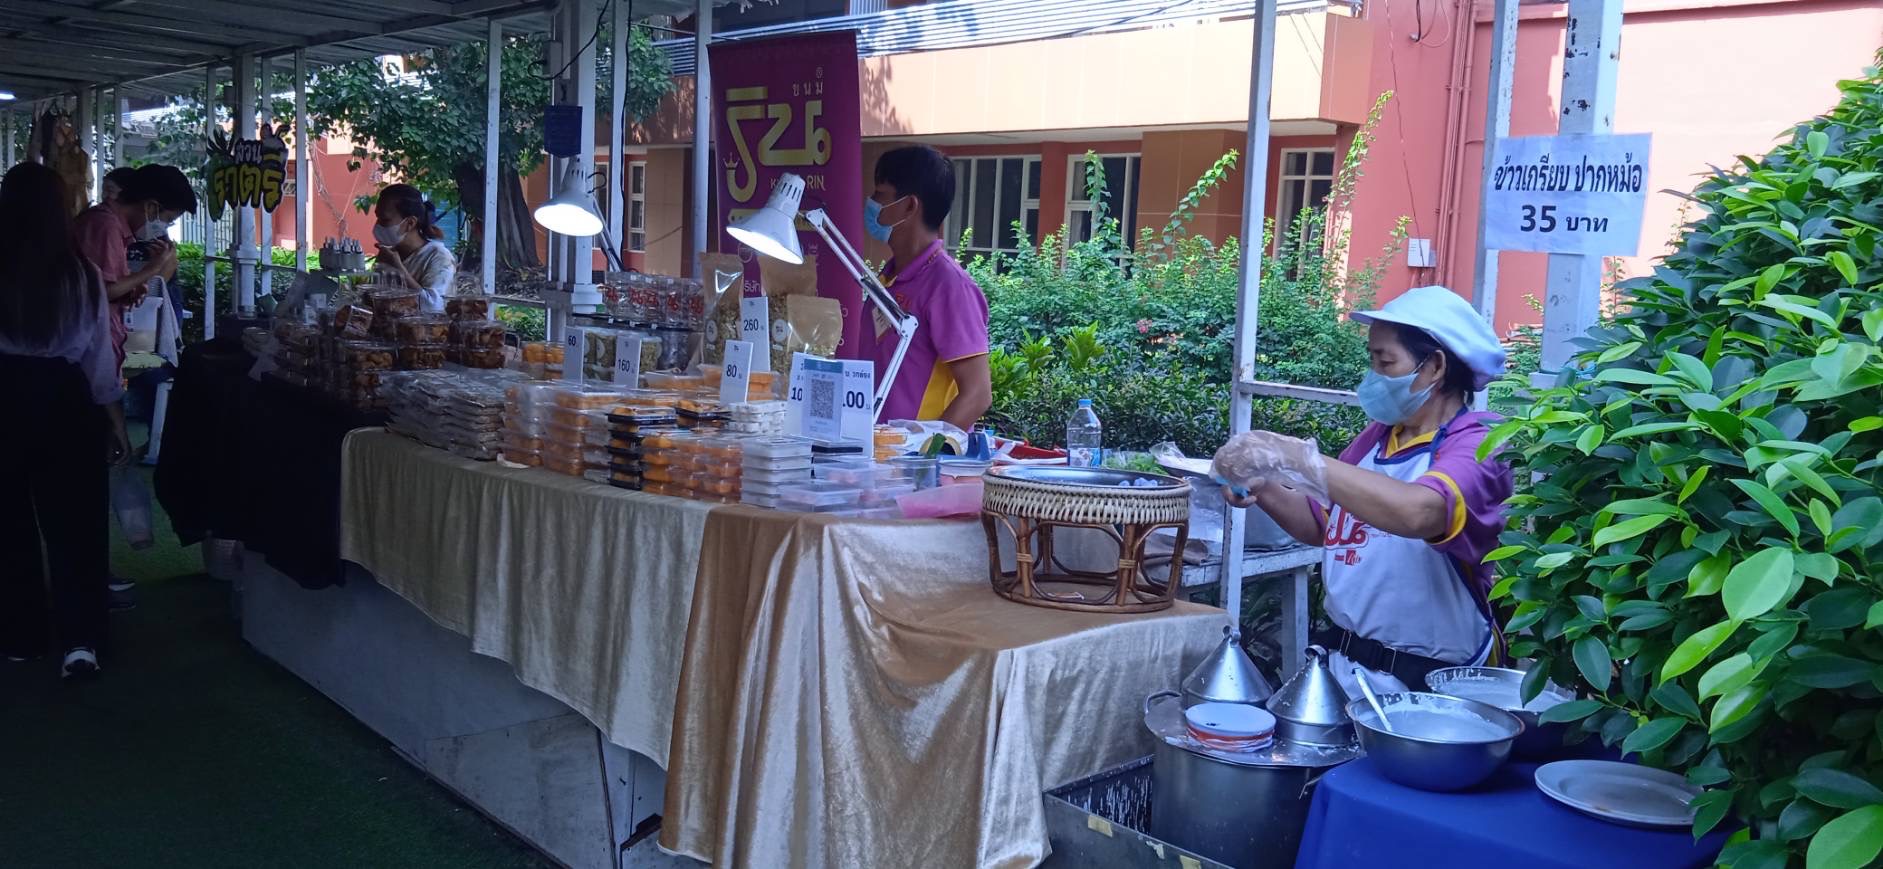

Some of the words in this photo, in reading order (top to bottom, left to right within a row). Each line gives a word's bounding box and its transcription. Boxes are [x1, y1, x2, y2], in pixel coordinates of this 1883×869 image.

[1494, 153, 1570, 192] ข้าวเกรียบ
[1573, 152, 1643, 193] ปากหม้อ
[1520, 204, 1557, 233] 35
[1565, 216, 1609, 233] บาท
[743, 318, 759, 332] 260
[568, 335, 577, 346] 60
[618, 359, 631, 373] 160
[726, 364, 738, 378] 80
[791, 386, 803, 401] 10
[843, 390, 865, 409] 00
